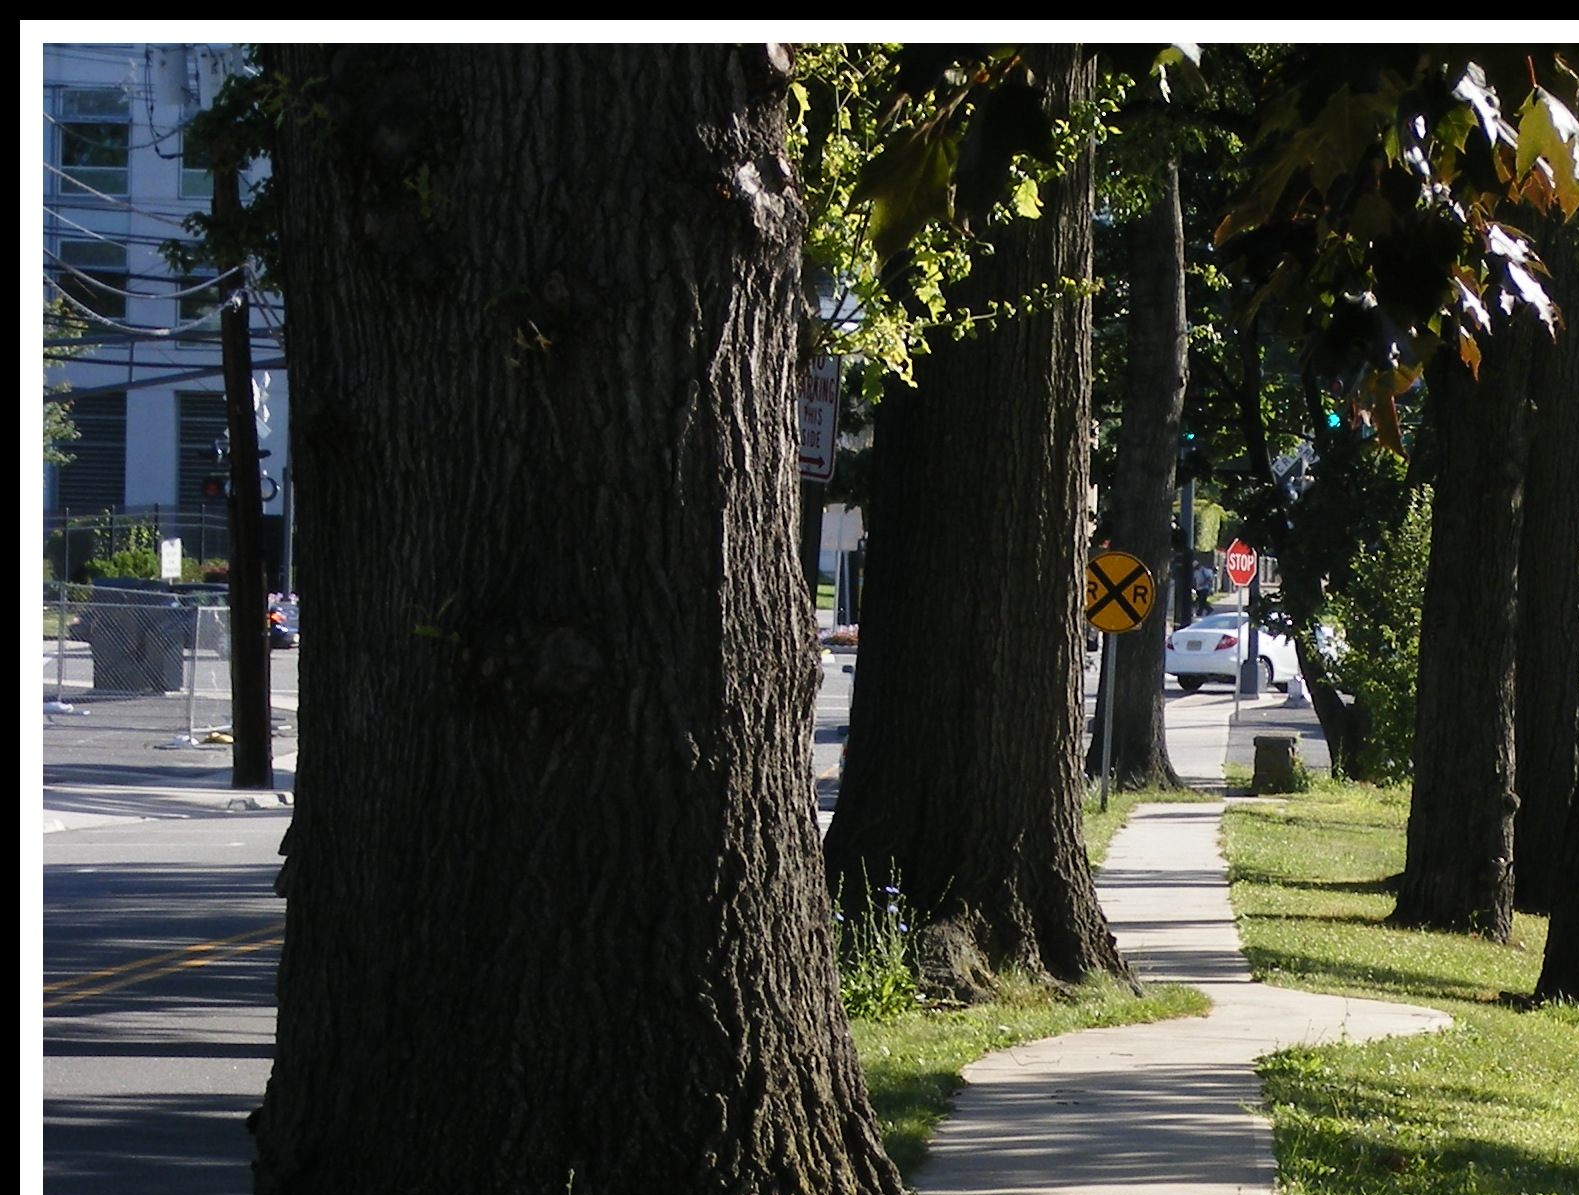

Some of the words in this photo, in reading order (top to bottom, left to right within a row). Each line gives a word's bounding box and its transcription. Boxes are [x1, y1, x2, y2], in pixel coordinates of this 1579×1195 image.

[800, 429, 821, 448] SIDE
[1229, 553, 1254, 572] STOP
[1133, 585, 1148, 604] R
